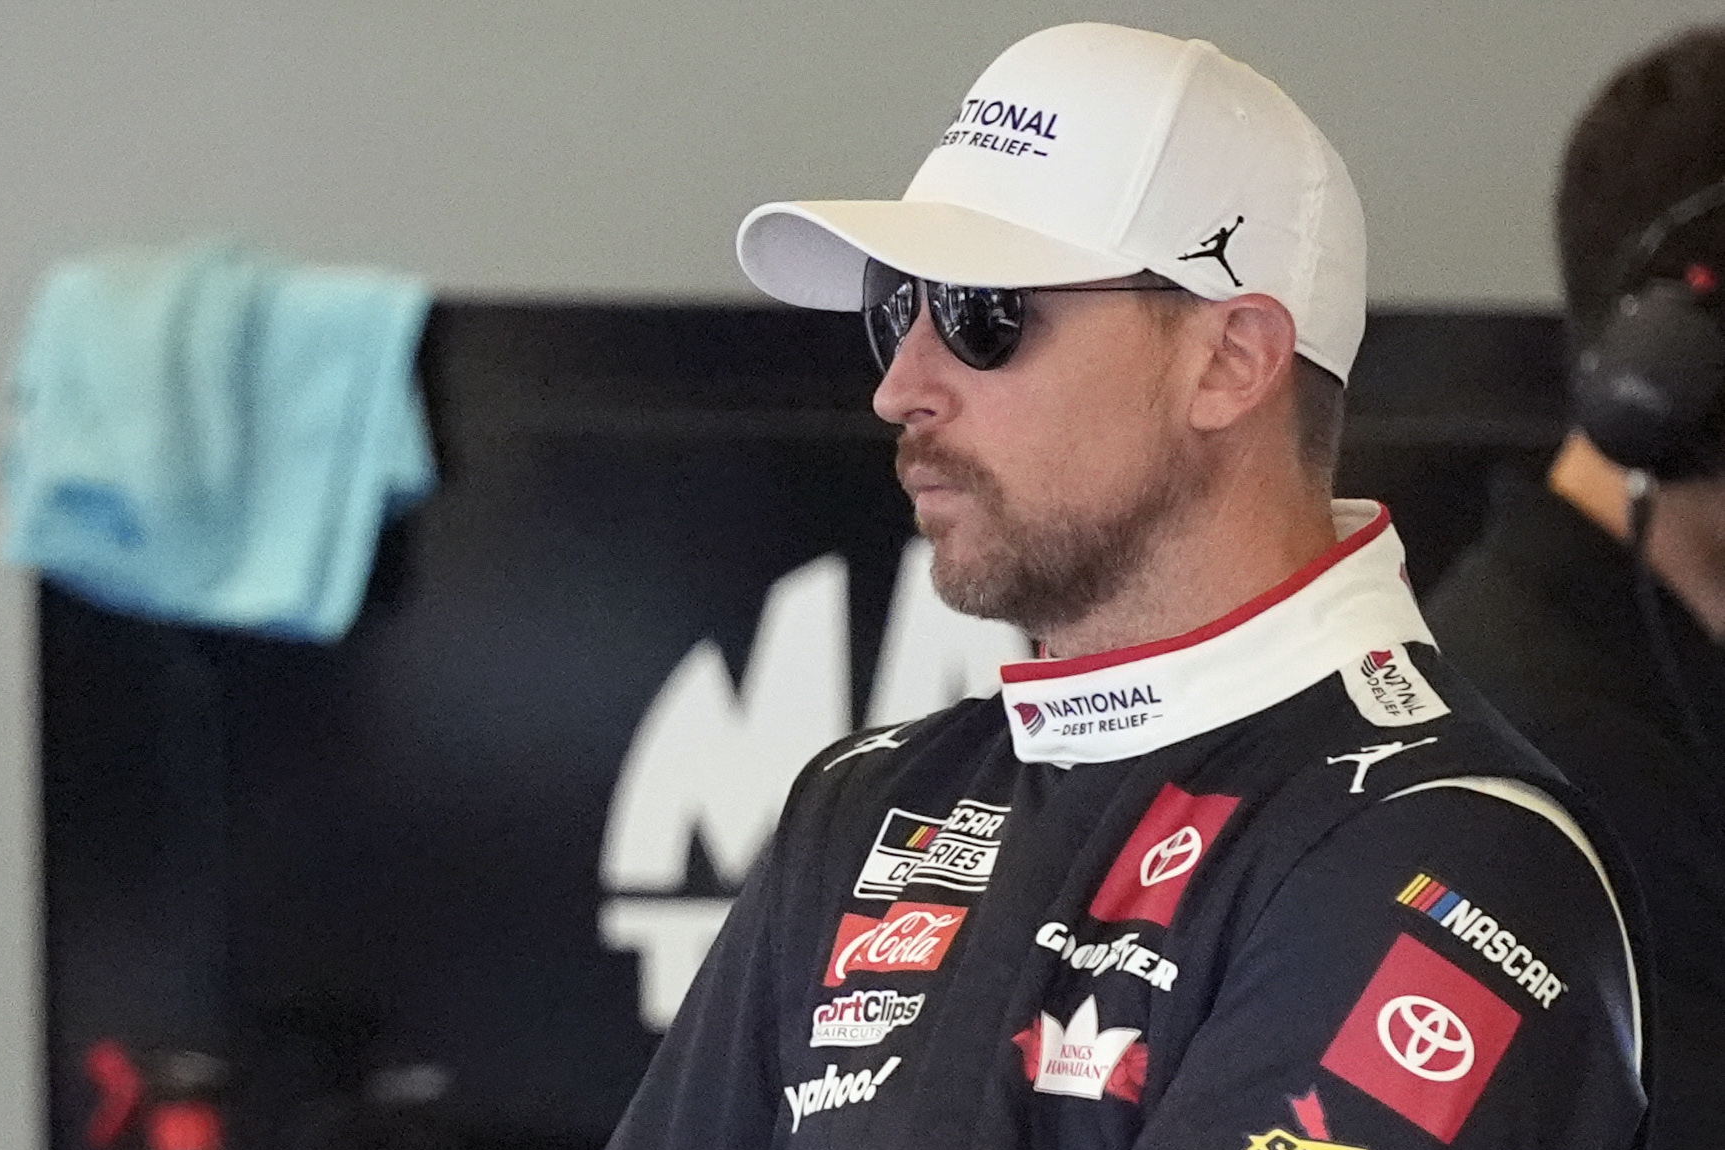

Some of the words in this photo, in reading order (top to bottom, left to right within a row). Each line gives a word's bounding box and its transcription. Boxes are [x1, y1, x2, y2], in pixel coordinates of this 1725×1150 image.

[957, 99, 1058, 140] TIONAL
[941, 130, 970, 146] EBT
[968, 132, 1032, 156] RELIEF
[1045, 684, 1162, 718] NATIONAL
[1061, 721, 1095, 736] DEBT
[1098, 713, 1149, 733] RELIEF
[928, 843, 986, 870] RIES
[1440, 898, 1562, 1010] NASCAR
[784, 1056, 902, 1134] yahoo!
